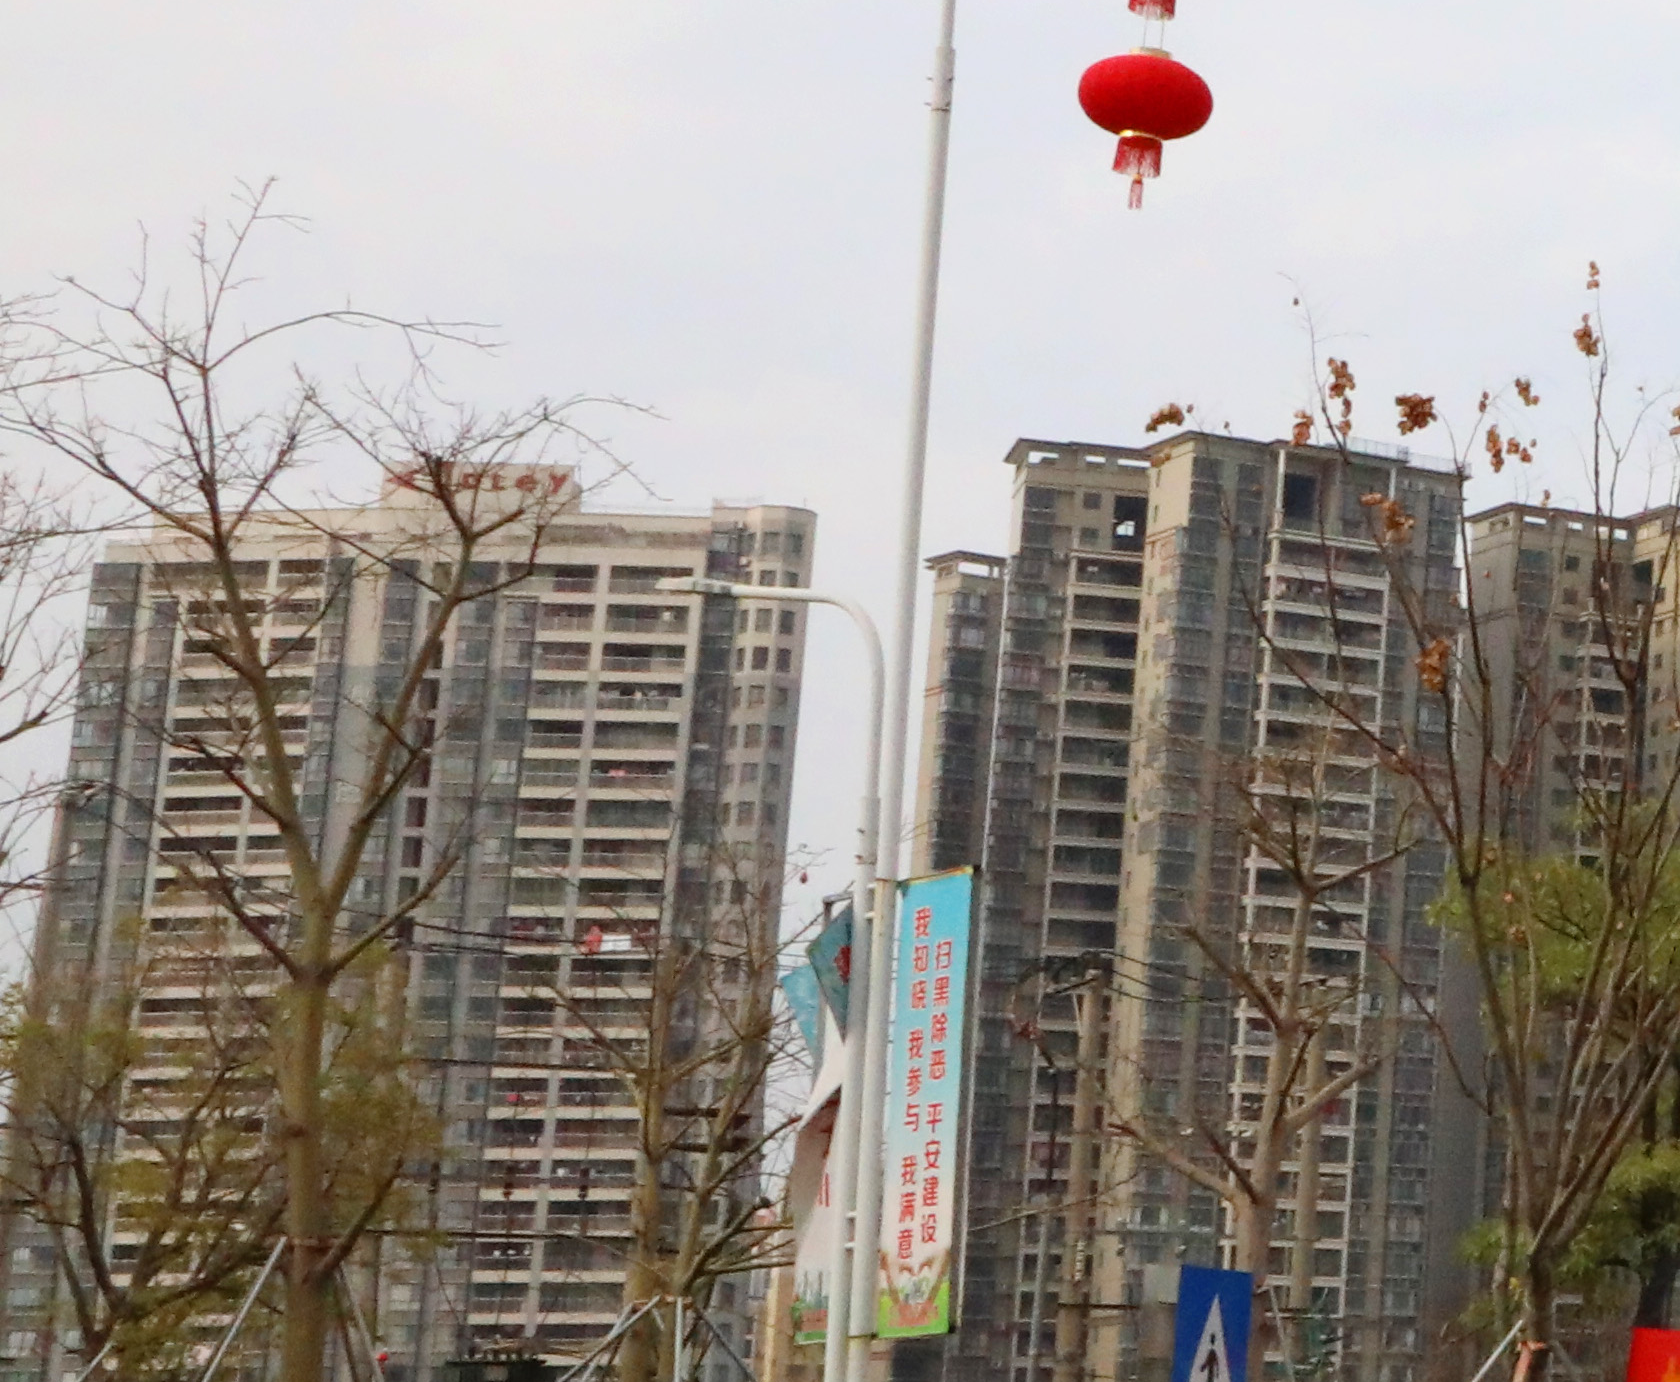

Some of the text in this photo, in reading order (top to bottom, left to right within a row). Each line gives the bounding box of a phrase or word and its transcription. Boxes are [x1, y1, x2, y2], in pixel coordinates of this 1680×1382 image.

[897, 906, 932, 1260] 我知晓 我参与 我满意
[921, 940, 953, 1244] 扫黑除恶 平安建设
